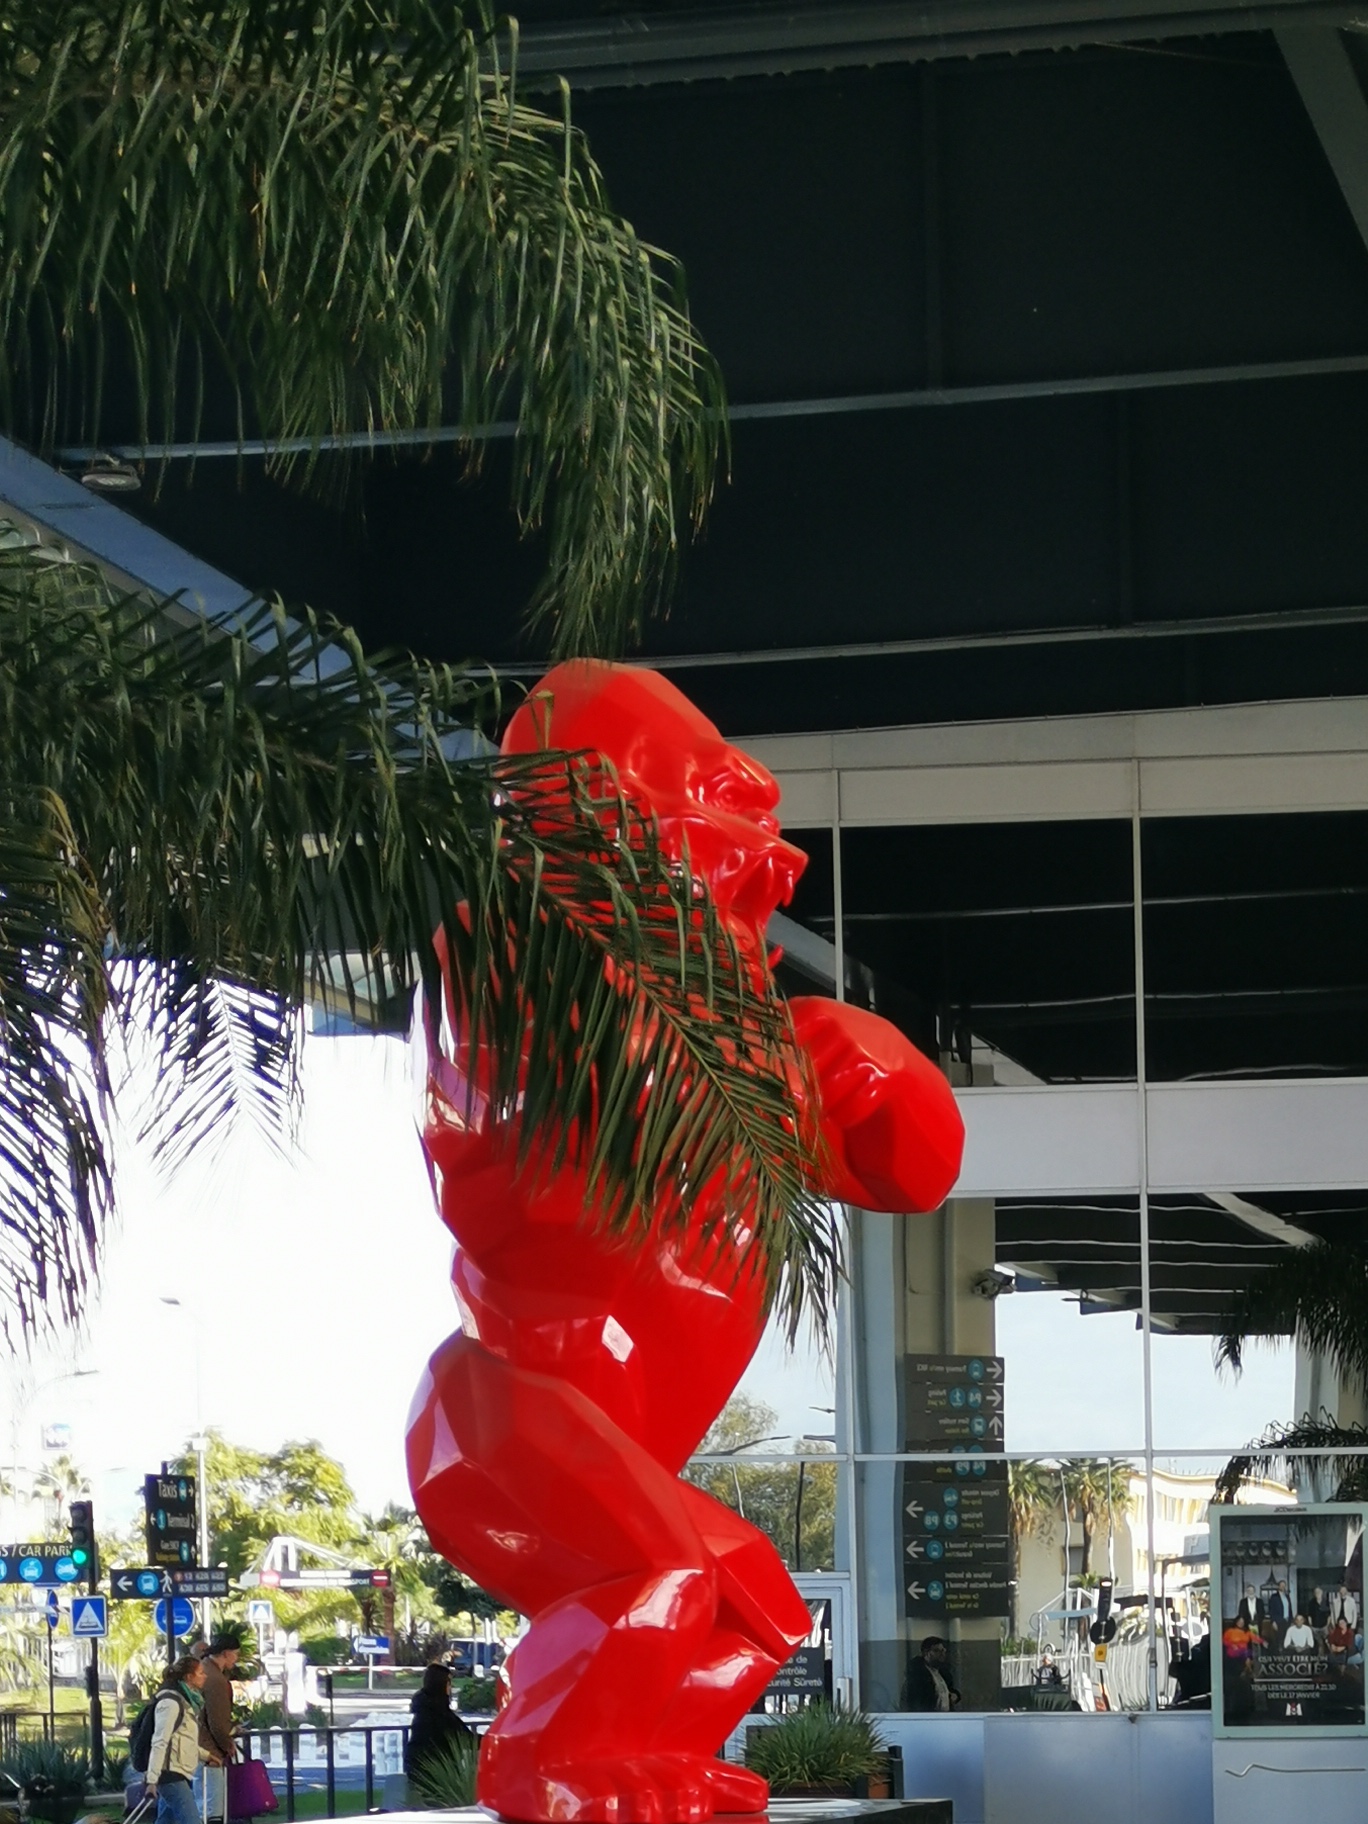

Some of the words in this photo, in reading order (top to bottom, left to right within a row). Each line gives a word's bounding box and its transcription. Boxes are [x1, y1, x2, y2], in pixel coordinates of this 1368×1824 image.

[156, 1479, 178, 1499] Taxis
[167, 1512, 190, 1528] Terminal
[18, 1545, 42, 1557] CAR
[795, 1654, 808, 1664] de
[793, 1676, 823, 1687] Sûreté
